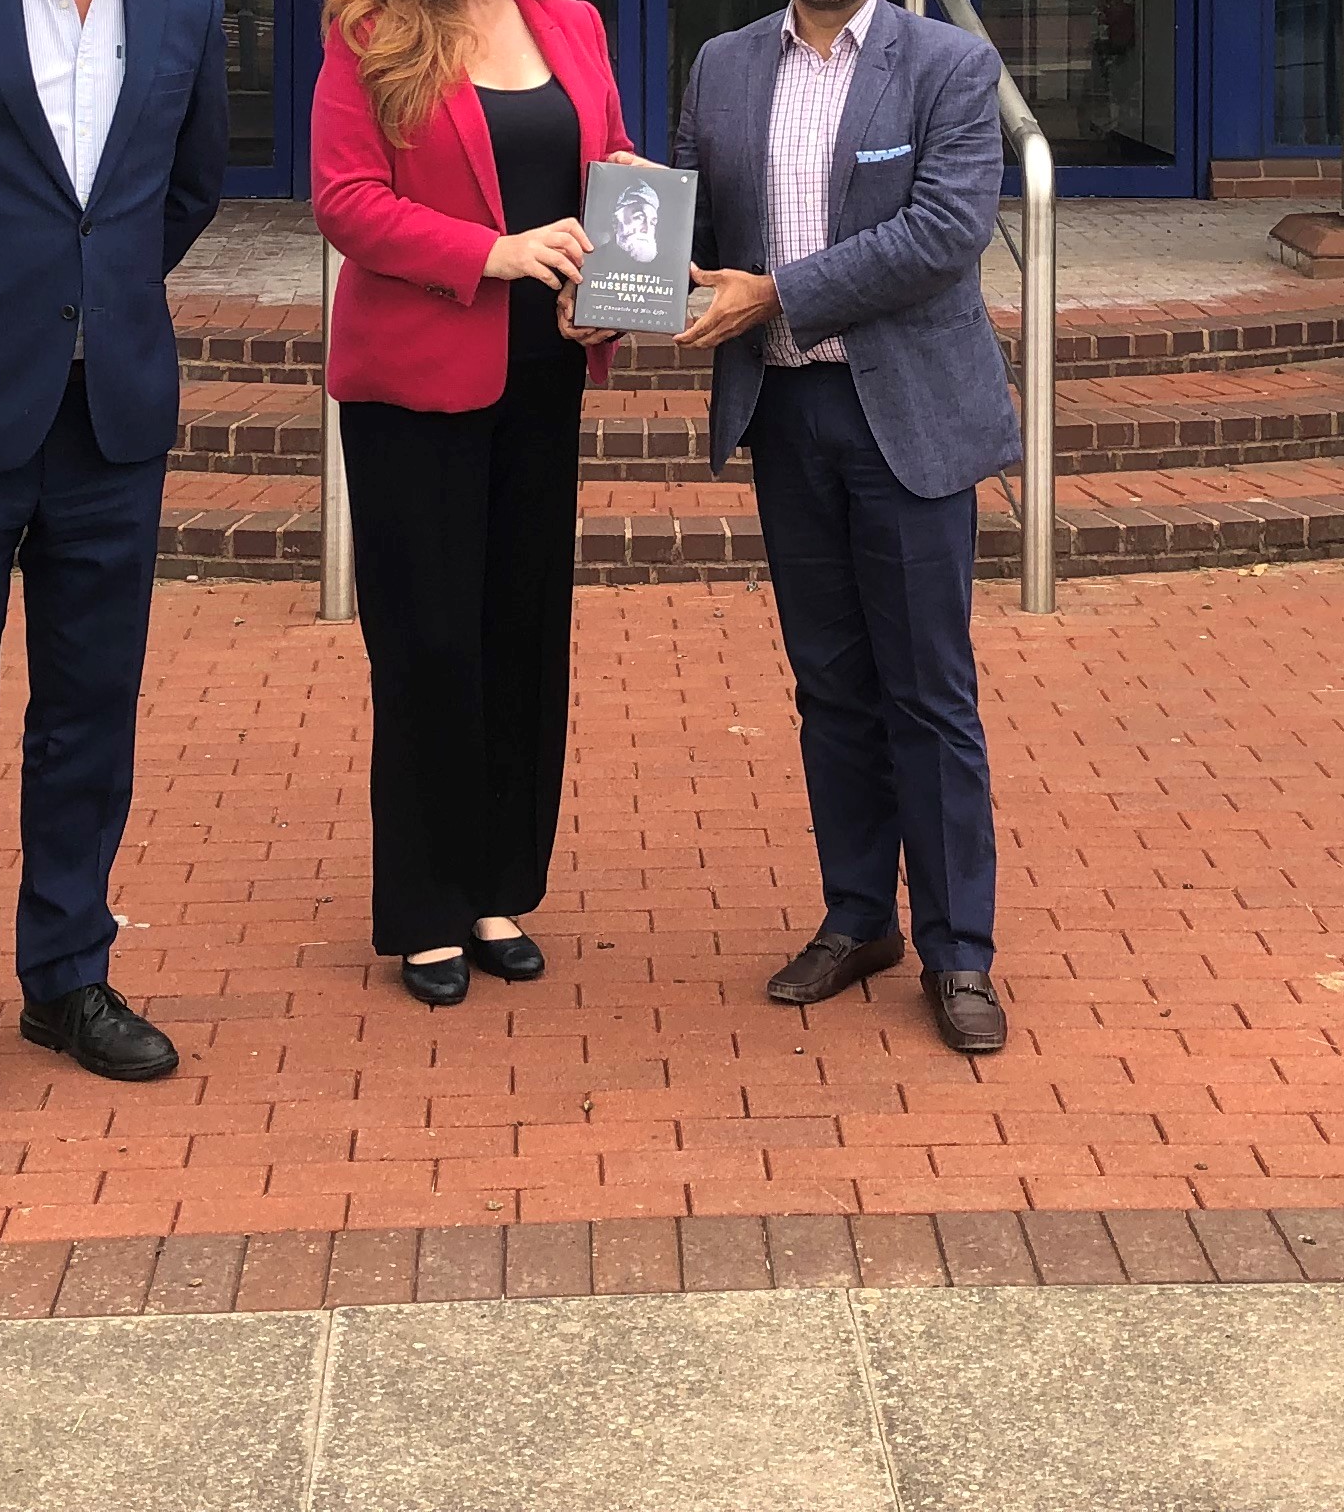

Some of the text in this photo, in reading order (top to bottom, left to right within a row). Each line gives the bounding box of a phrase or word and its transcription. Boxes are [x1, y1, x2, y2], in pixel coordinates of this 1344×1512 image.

[605, 272, 661, 285] JAMSETJI
[590, 280, 674, 296] NUSSERWANJI
[616, 292, 645, 304] TATA
